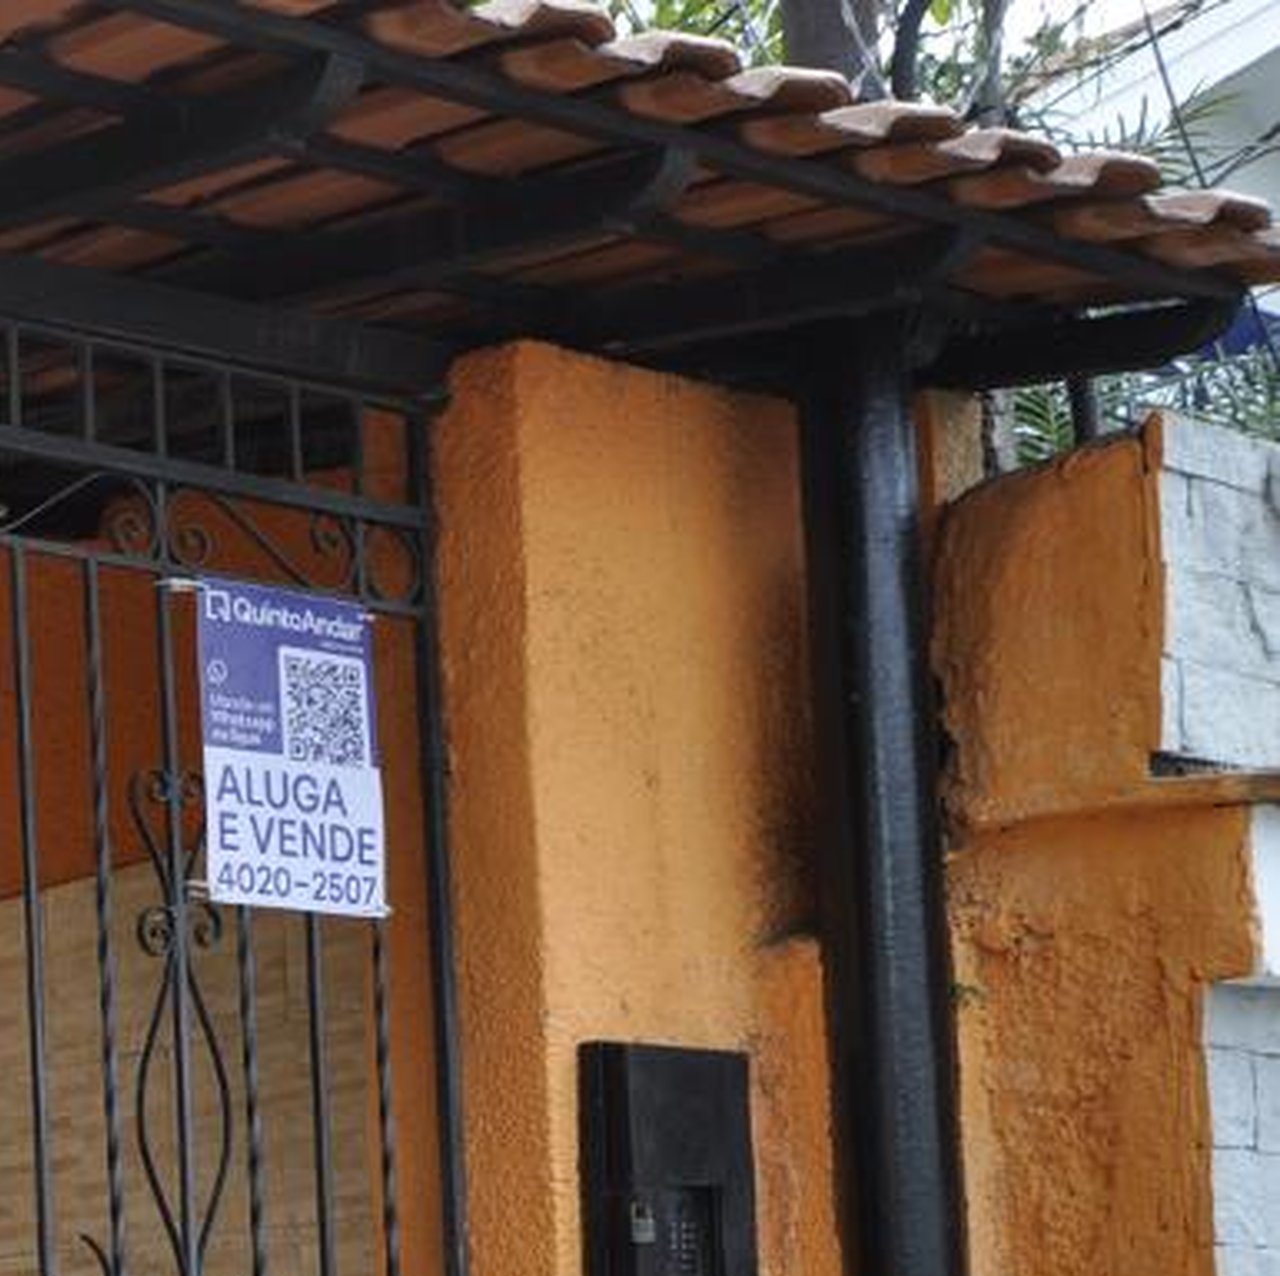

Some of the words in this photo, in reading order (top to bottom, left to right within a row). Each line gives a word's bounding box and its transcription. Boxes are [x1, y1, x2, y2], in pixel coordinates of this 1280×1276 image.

[233, 597, 364, 641] QuintoAndar
[217, 765, 348, 817] ALUGA
[220, 812, 239, 852] E
[250, 815, 377, 866] VENDE
[217, 862, 377, 904] 4020-2507
